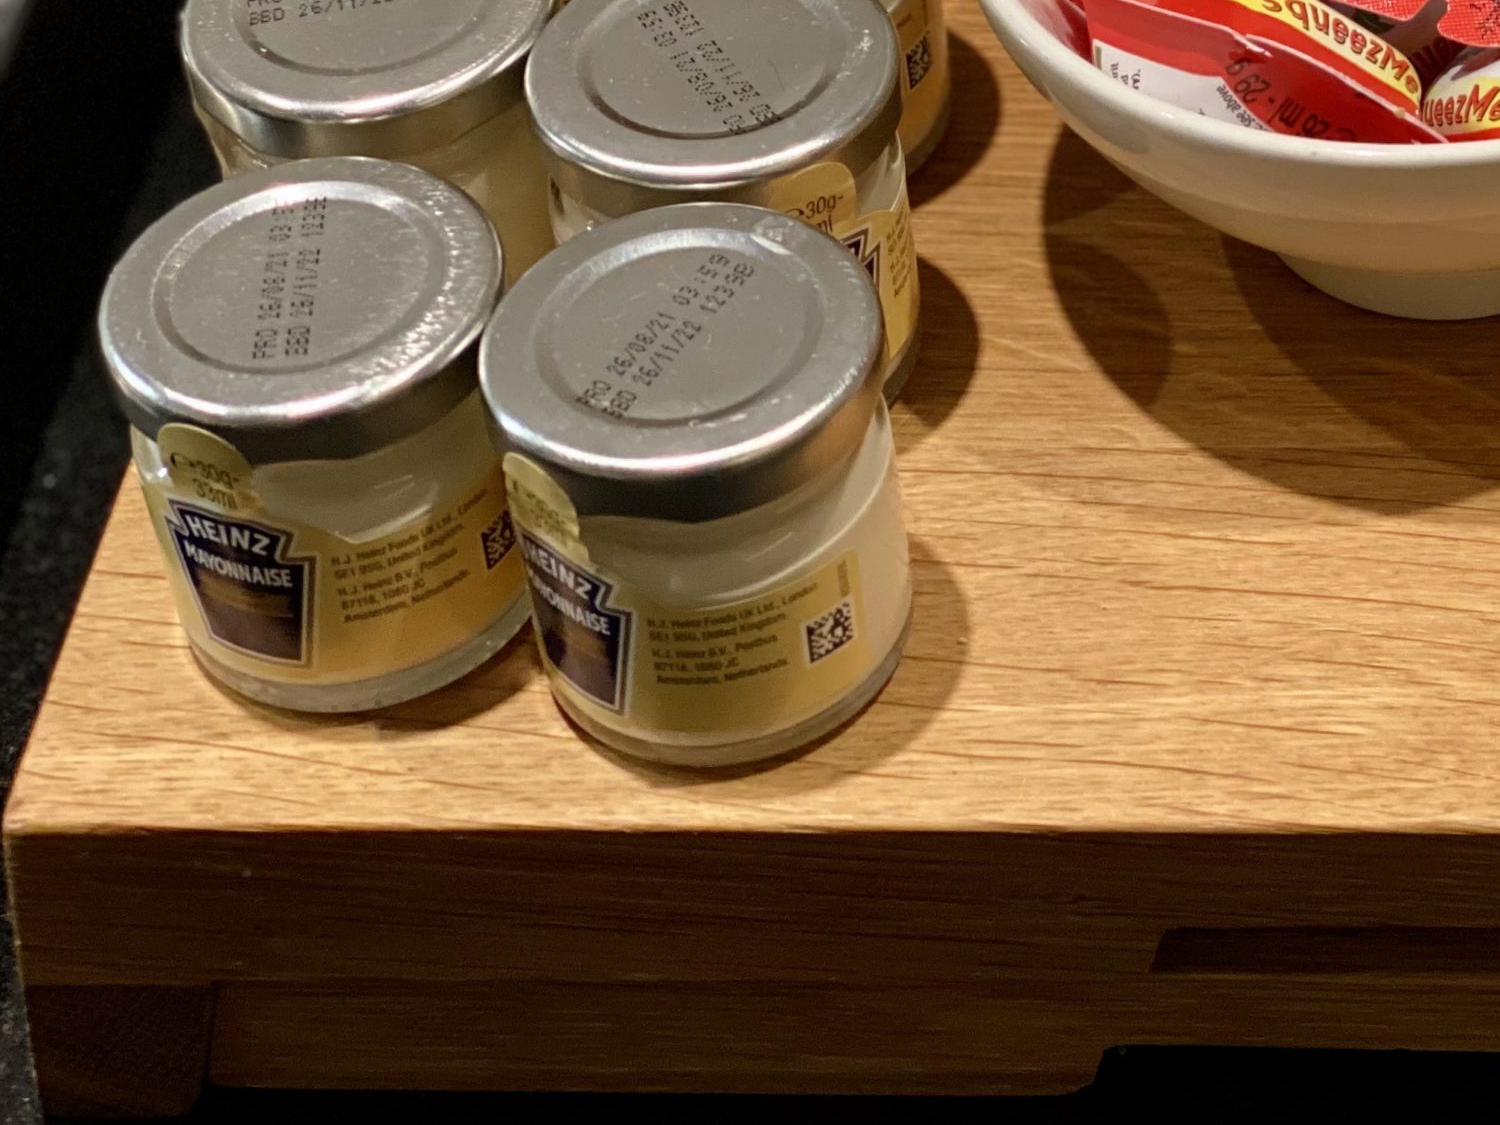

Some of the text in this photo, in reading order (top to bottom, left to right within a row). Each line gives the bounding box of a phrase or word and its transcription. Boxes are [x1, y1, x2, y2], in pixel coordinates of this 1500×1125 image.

[606, 311, 677, 376] 26/08/21
[672, 254, 730, 306] 03:59
[632, 321, 702, 387] 26/11/22
[699, 263, 755, 314] 1239B
[184, 514, 270, 555] HEINZ
[184, 540, 293, 588] MAYONNAISE
[525, 539, 593, 600] HEINZ
